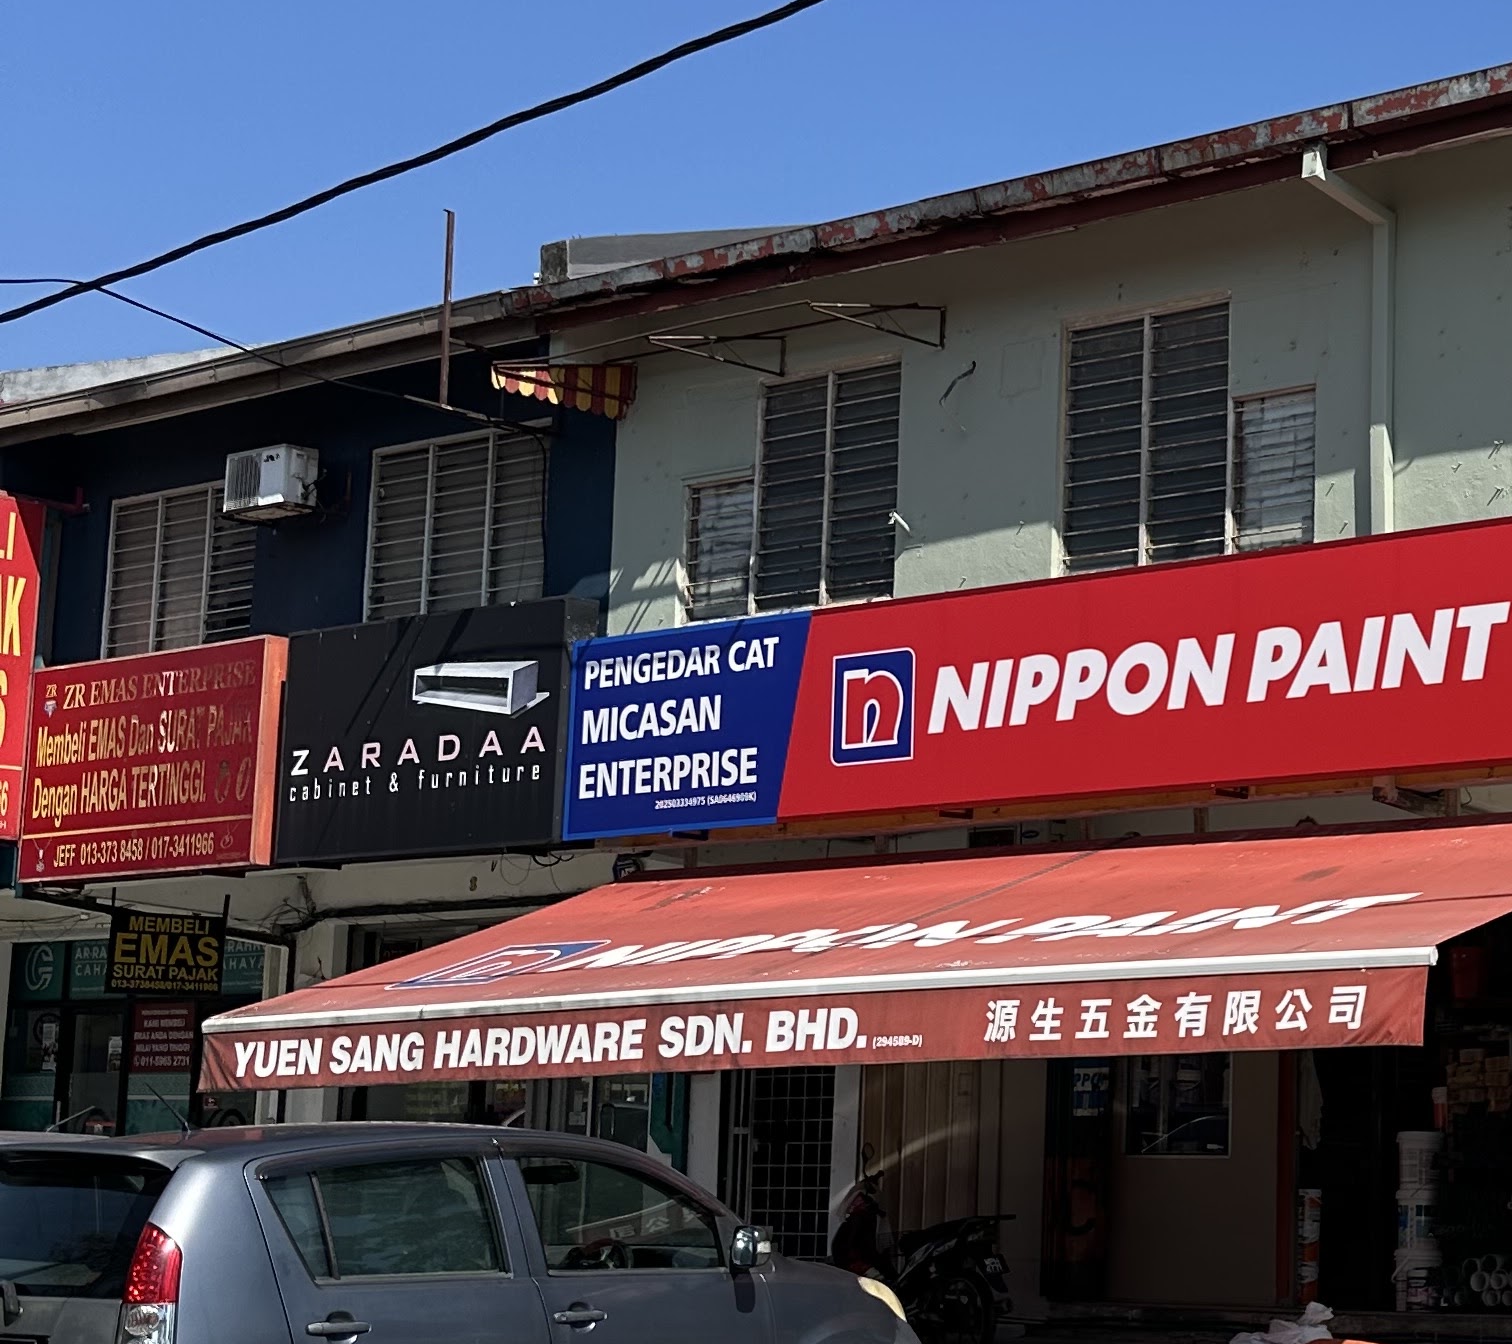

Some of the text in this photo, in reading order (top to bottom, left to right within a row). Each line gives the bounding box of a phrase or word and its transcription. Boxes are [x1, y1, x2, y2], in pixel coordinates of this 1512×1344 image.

[62, 659, 256, 710] ZR EMAS ENTERPRISE
[583, 636, 779, 690] PENGEDAR CAT
[927, 601, 1511, 734] NIPPON PAINT
[36, 721, 87, 767] Membeli
[88, 715, 126, 761] EMAS
[128, 714, 154, 756] Dan
[157, 706, 204, 754] SURAT
[582, 694, 722, 745] MICASAN
[290, 726, 546, 776] ZARADAA
[578, 747, 758, 800] ENTERPRISE
[32, 778, 77, 828] Dengan
[80, 768, 127, 813] HARGA
[289, 764, 541, 802] cabinet & furniture
[53, 844, 76, 867] JEFF
[80, 841, 118, 865] 013-373
[120, 839, 144, 861] 8458
[151, 832, 215, 860] 017-3411966
[114, 932, 220, 967] EMAS
[128, 915, 210, 935] MEMBELI
[112, 964, 219, 981] SURAT PAJAK
[983, 984, 1368, 1044] 源生五金有限公司
[234, 1038, 322, 1079] YUEN
[329, 1031, 425, 1073] SANG
[433, 1018, 647, 1070] HARDWARE
[659, 1011, 754, 1059] SDN.
[766, 1006, 867, 1053] BHD.
